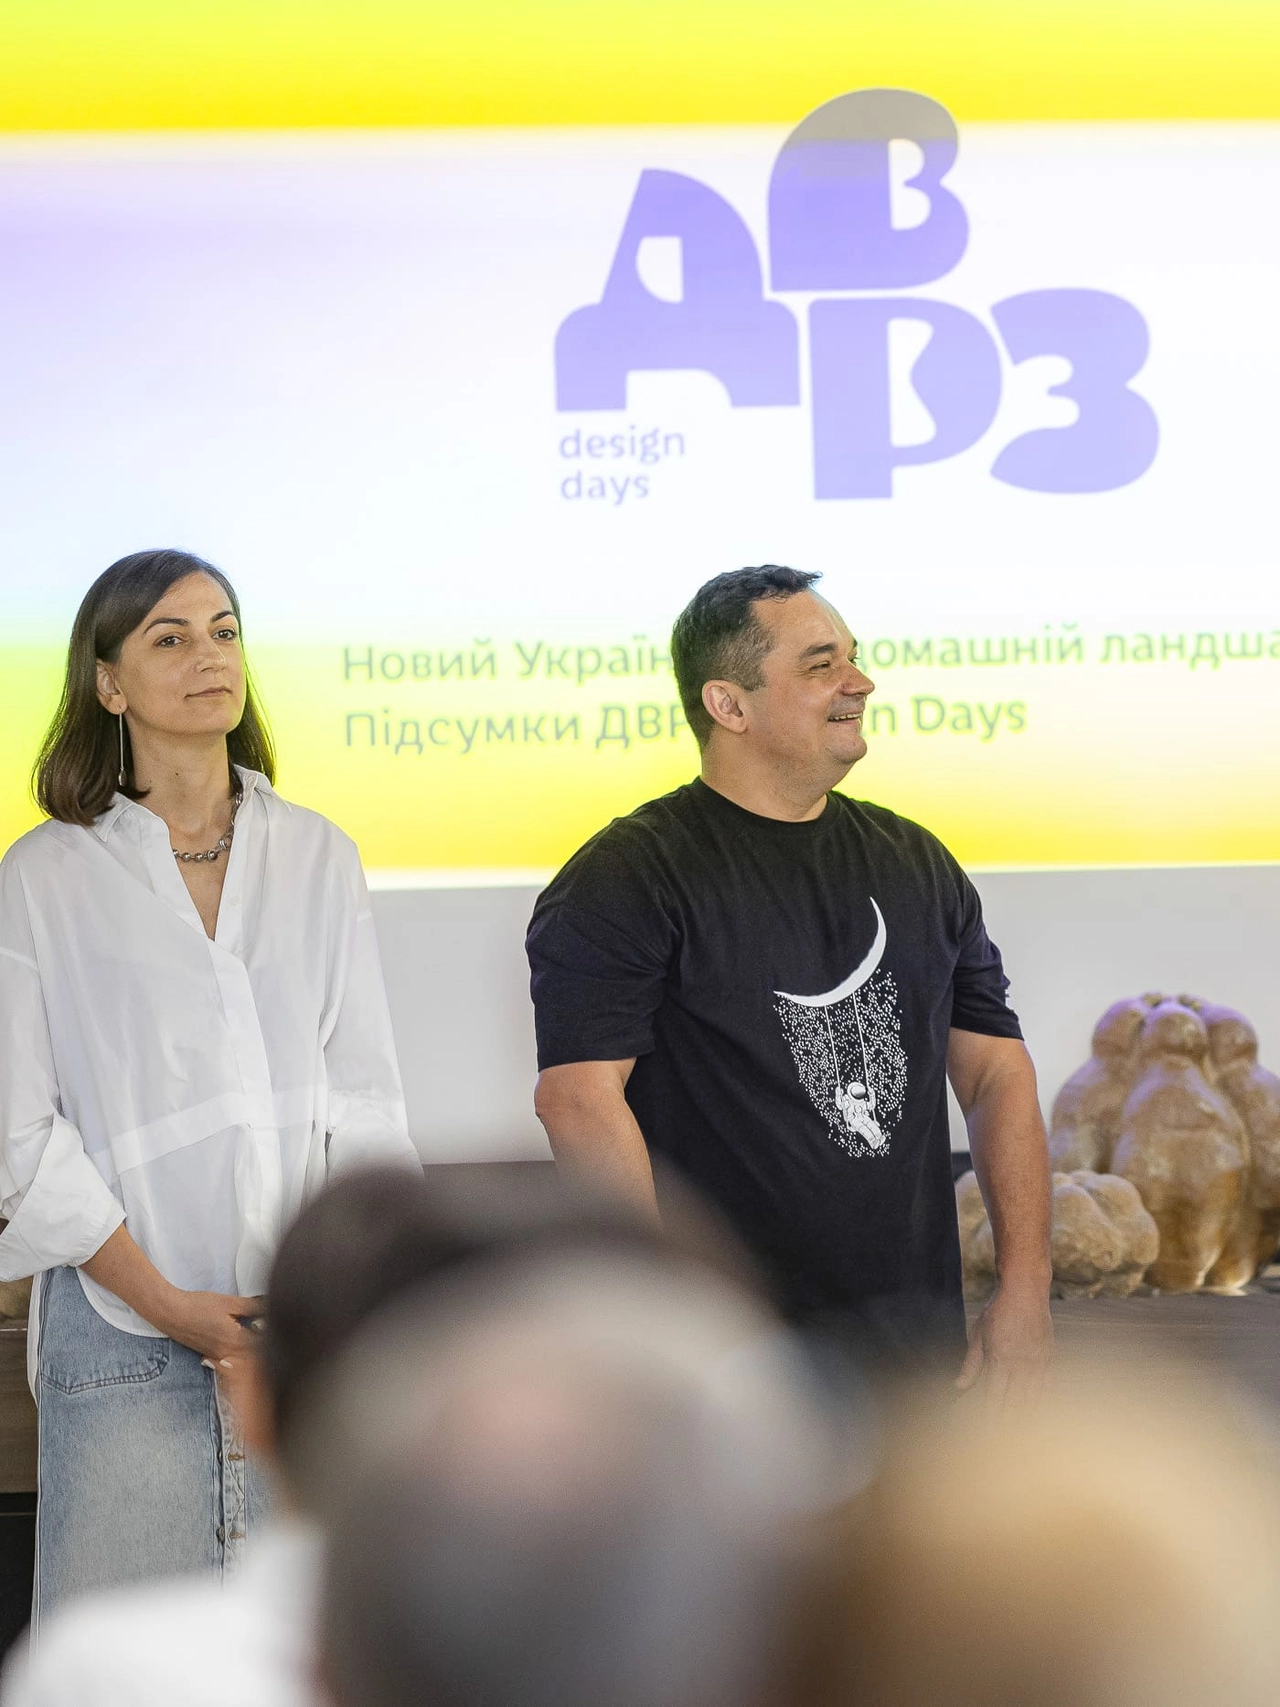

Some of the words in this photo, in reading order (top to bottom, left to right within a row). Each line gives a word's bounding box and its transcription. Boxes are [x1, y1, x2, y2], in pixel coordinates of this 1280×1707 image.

[560, 424, 686, 465] design
[561, 469, 651, 506] days
[343, 637, 496, 681] Новий
[515, 634, 675, 684] Україн
[345, 708, 580, 755] Підсумки
[594, 704, 688, 750] ДВР
[912, 696, 1026, 740] Days
